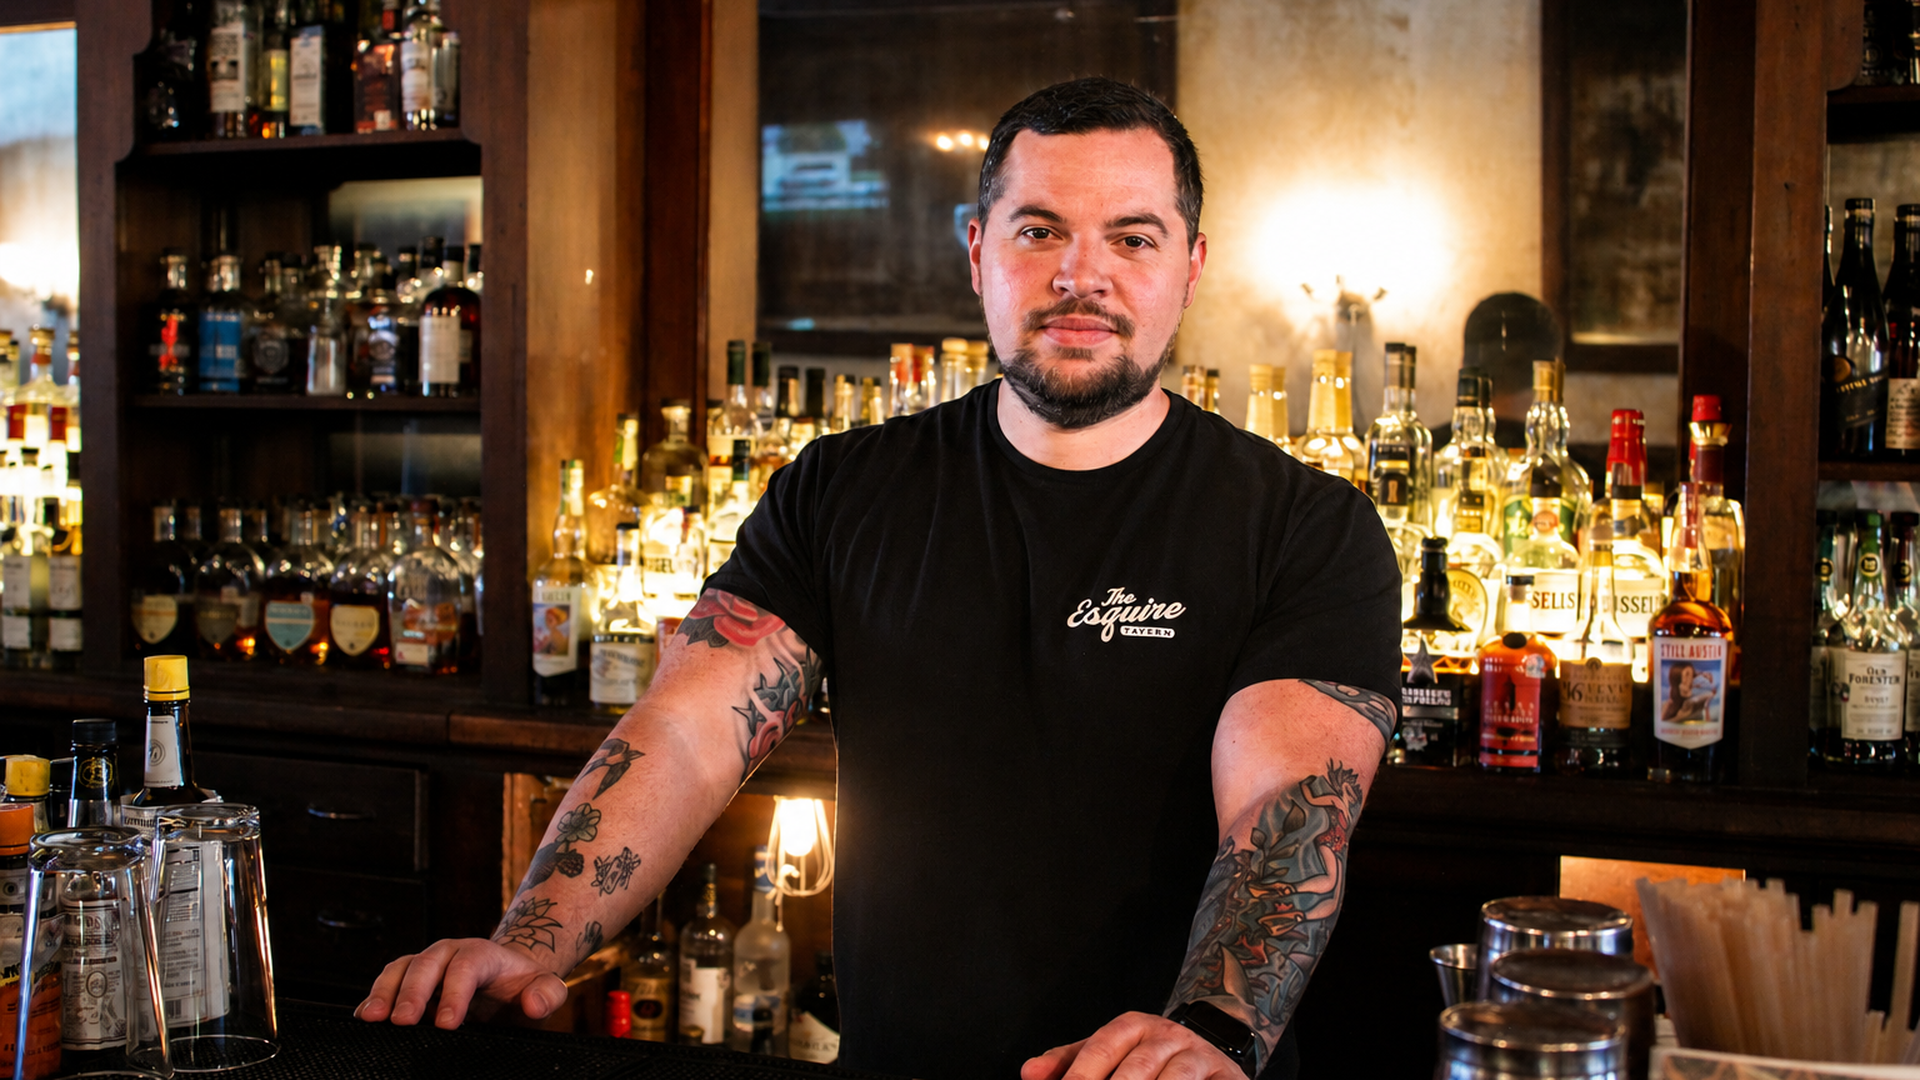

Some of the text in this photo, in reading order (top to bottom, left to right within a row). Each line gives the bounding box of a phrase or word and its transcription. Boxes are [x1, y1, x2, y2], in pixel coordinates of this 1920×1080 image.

[1101, 587, 1137, 607] The
[1066, 598, 1186, 642] Esquire
[1123, 626, 1173, 638] TAVERN
[1661, 643, 1685, 658] STILL
